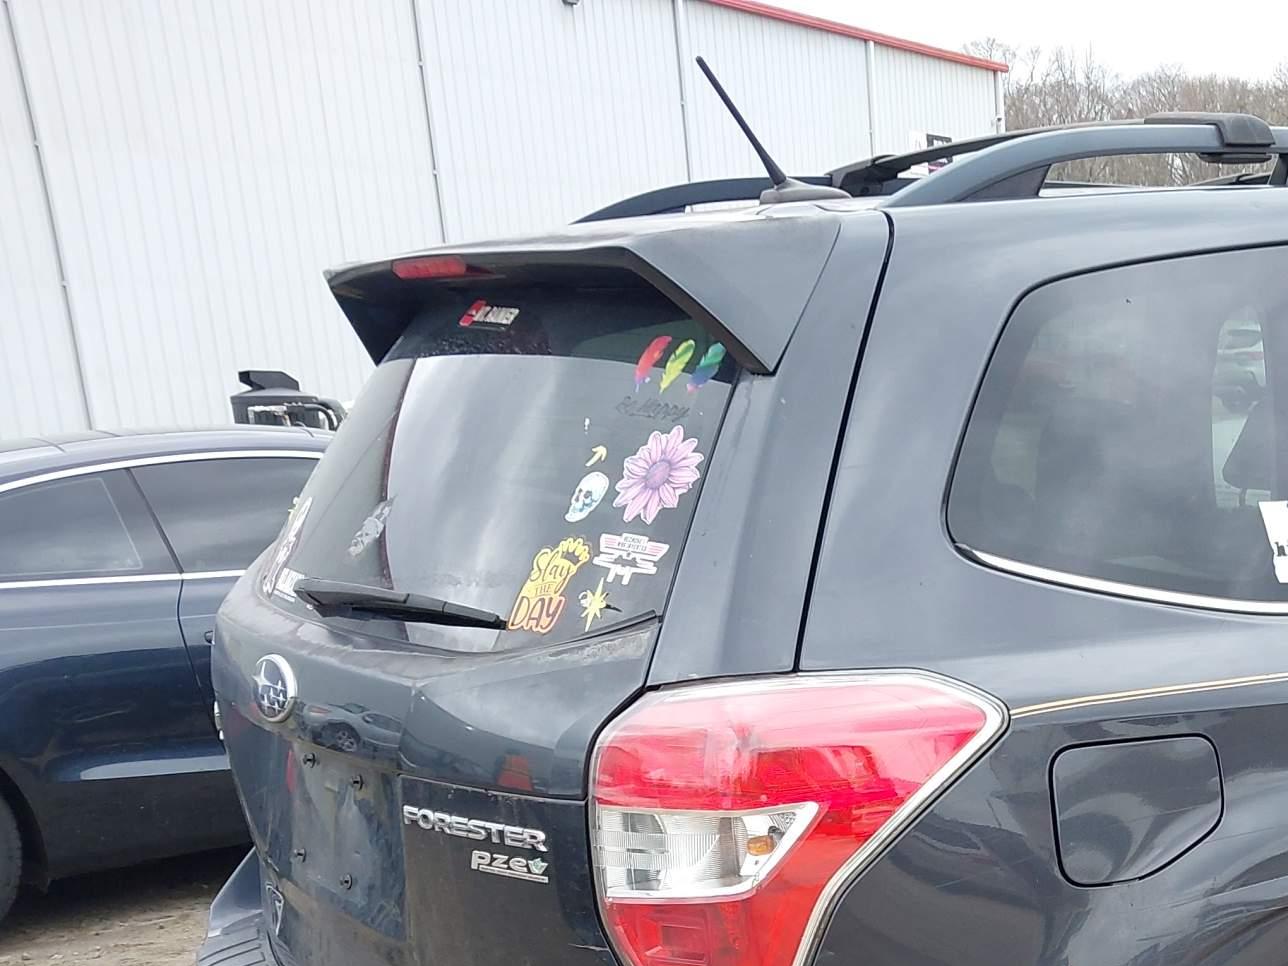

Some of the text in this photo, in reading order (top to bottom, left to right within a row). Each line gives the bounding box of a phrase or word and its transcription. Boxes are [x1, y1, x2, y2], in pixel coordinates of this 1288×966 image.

[530, 551, 571, 594] Slay
[535, 583, 554, 595] THE
[511, 596, 564, 630] DAY
[402, 804, 548, 853] FORESTER
